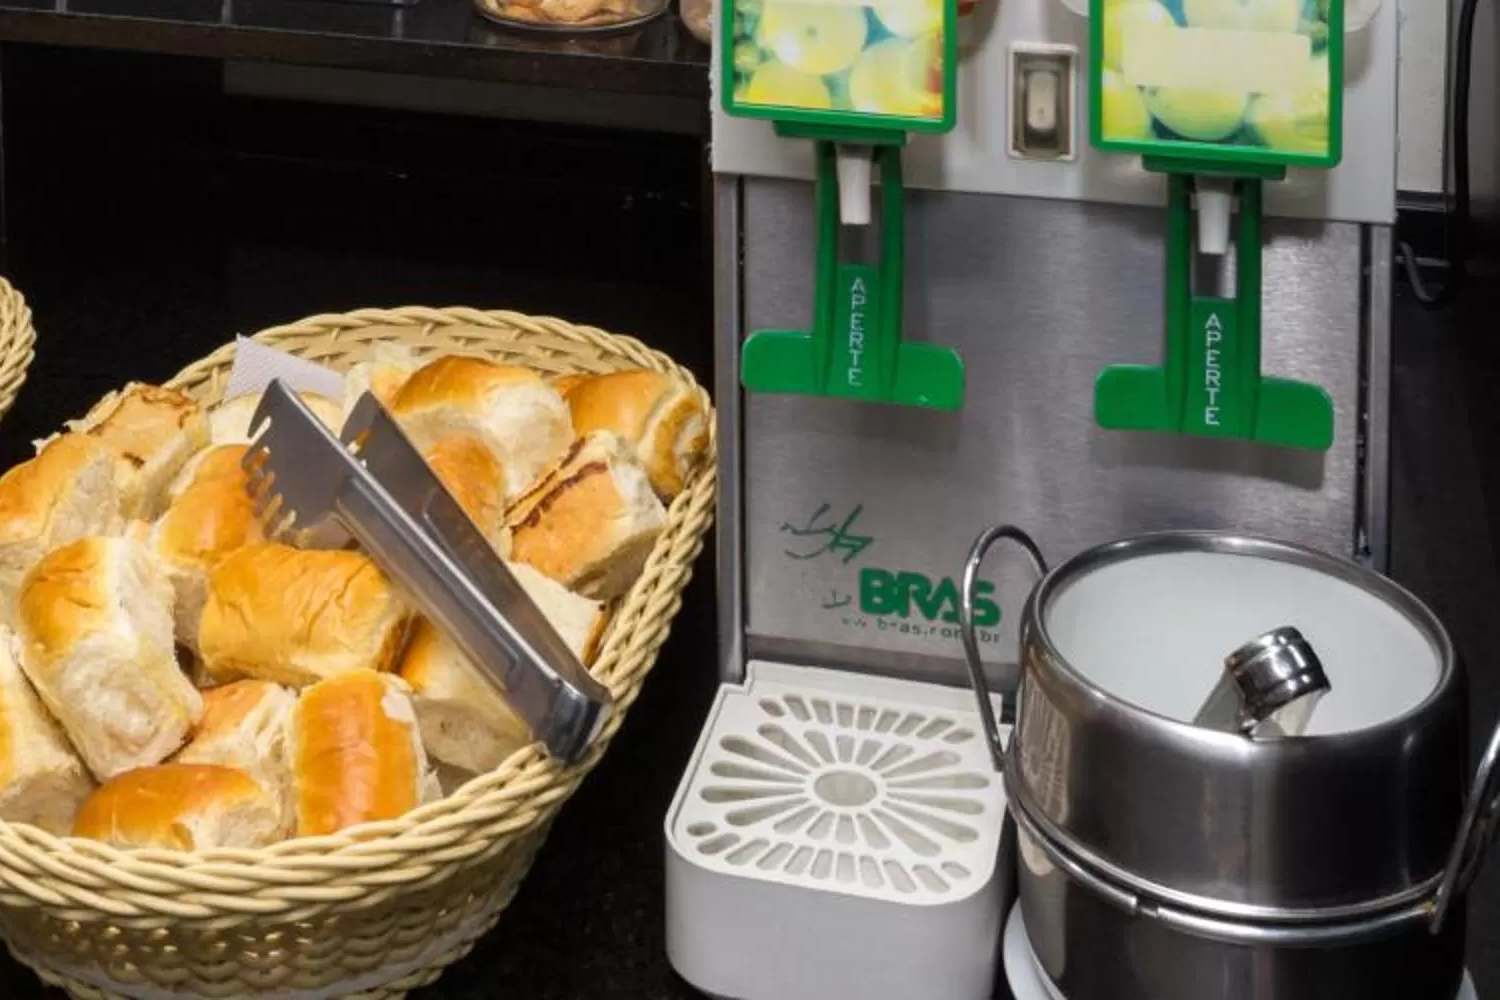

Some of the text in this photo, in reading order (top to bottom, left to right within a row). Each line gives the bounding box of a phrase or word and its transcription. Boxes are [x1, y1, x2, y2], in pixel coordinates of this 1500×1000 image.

[848, 277, 866, 387] APERTE
[1204, 312, 1222, 425] APERTE
[860, 568, 1002, 627] BRAS
